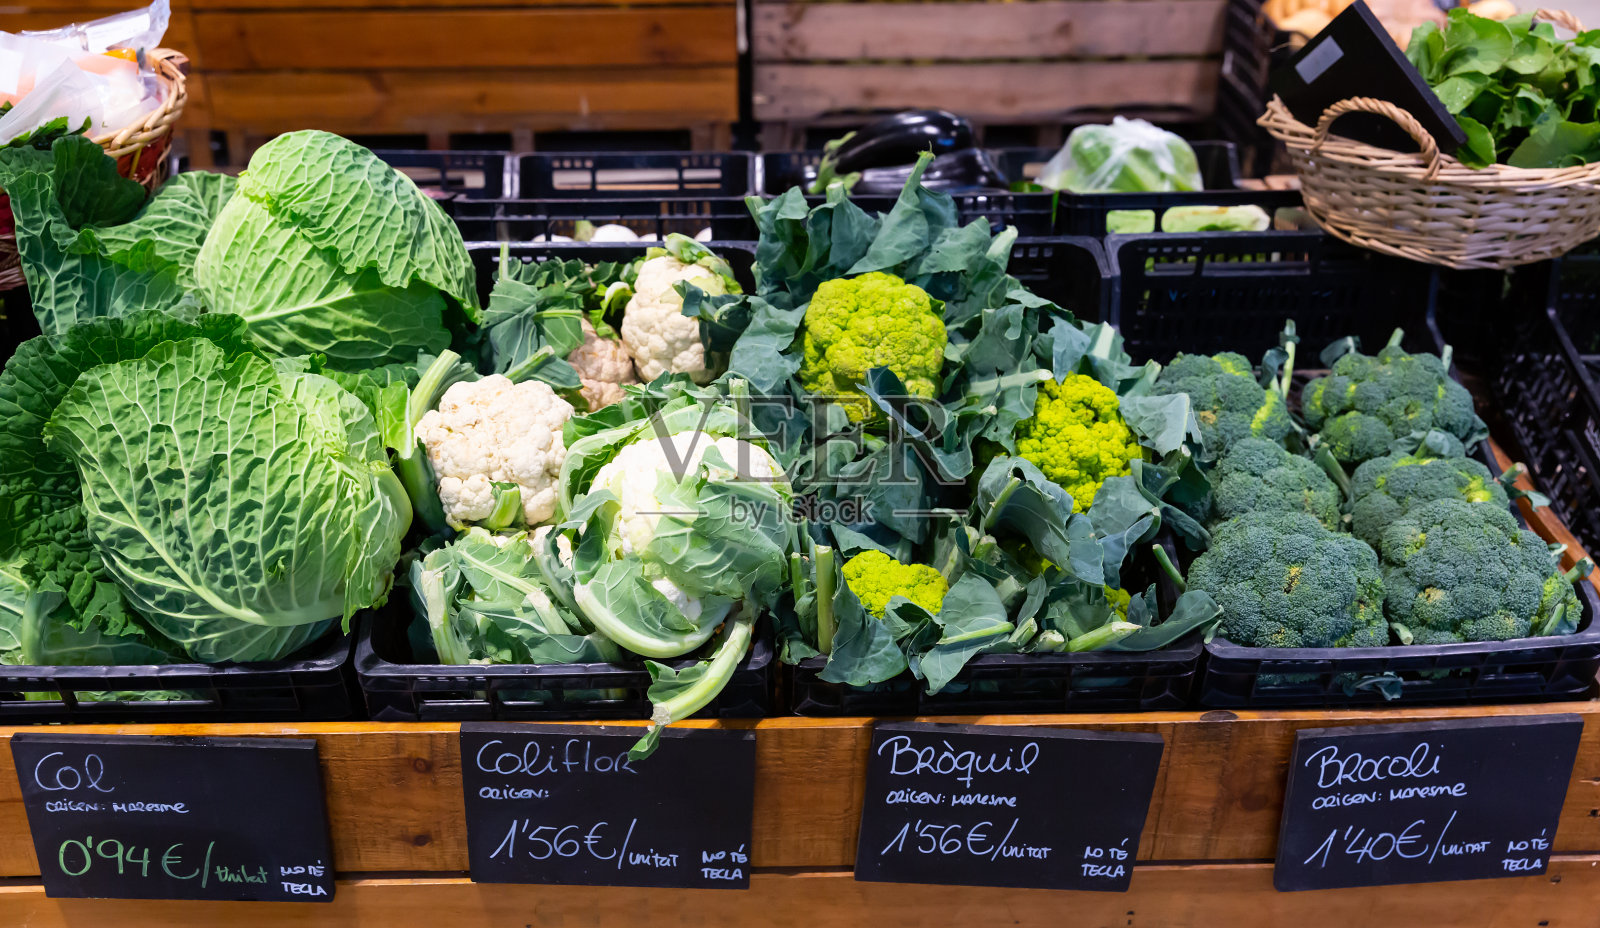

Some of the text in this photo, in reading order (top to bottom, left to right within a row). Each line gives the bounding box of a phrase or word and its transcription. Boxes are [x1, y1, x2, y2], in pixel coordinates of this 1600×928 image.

[878, 735, 1039, 788] Bròquil
[1305, 742, 1444, 788] Brocoli
[35, 752, 114, 792] Col
[1084, 838, 1128, 860] NO TÉ
[1507, 828, 1549, 853] NO TÉ
[702, 844, 747, 863] NO TÉ
[701, 868, 742, 880] TECLA
[1081, 863, 1125, 878] TECLA
[1502, 858, 1542, 871] TECLA
[281, 882, 327, 895] TECLA
